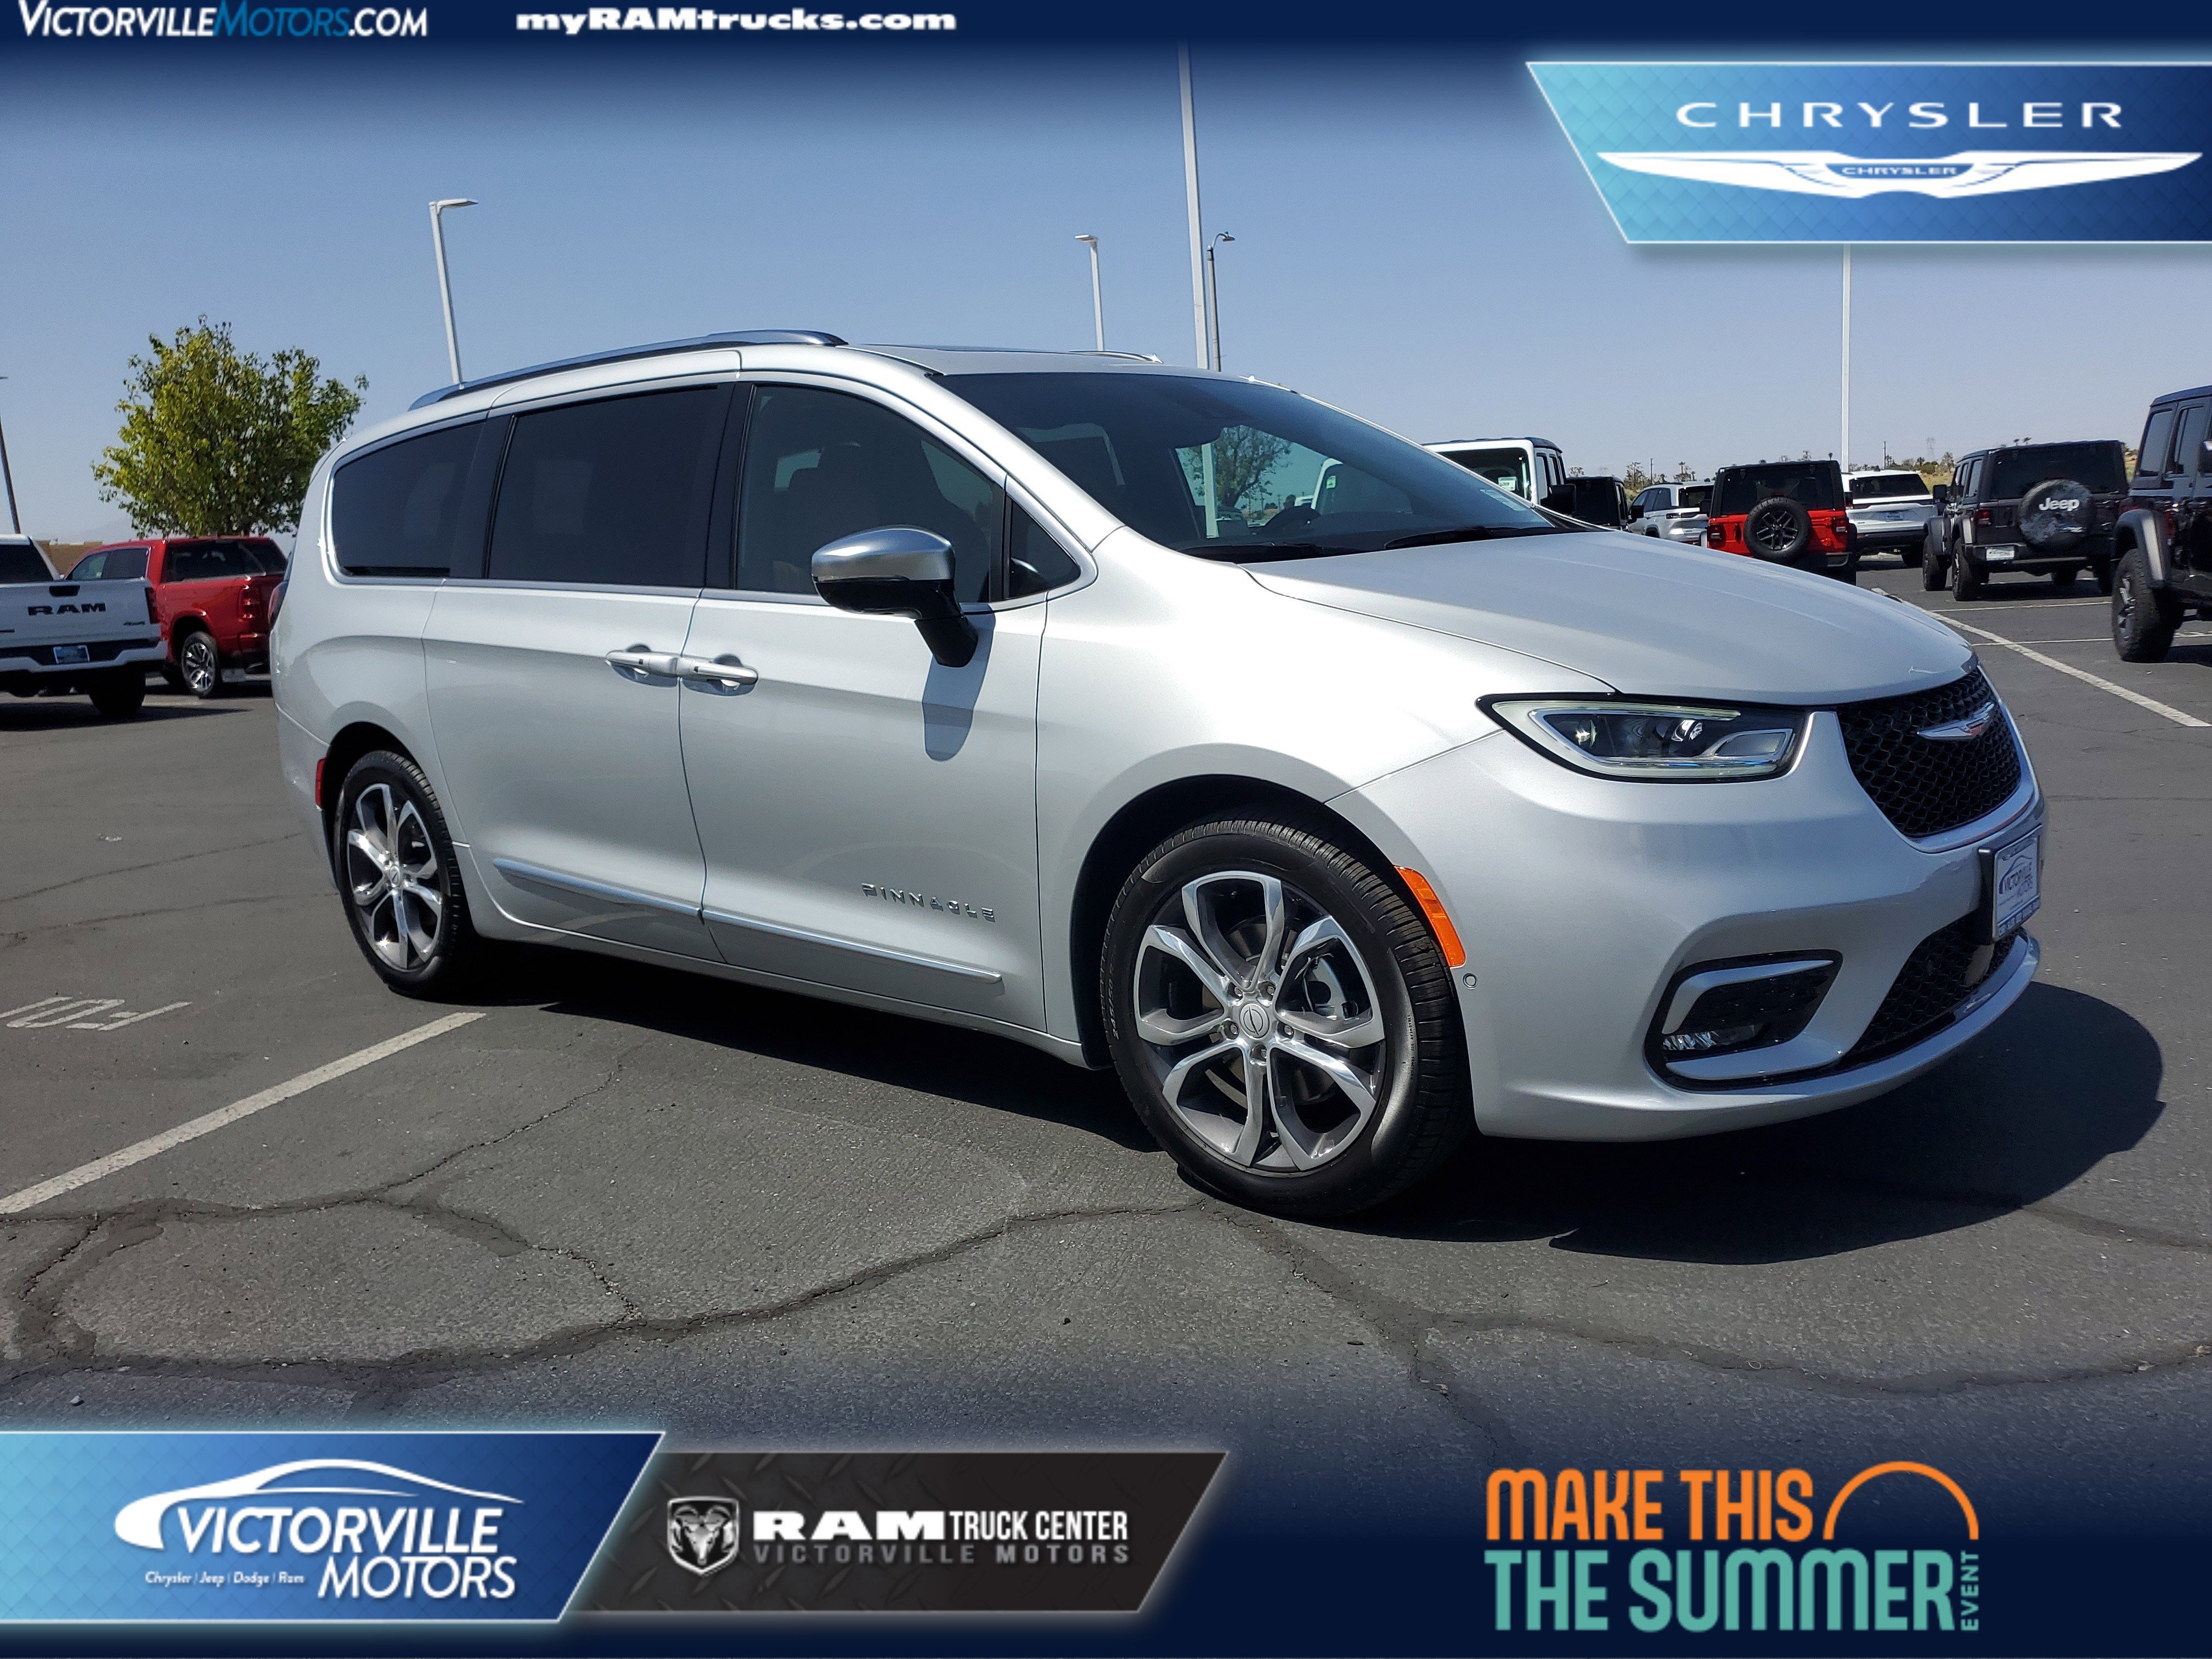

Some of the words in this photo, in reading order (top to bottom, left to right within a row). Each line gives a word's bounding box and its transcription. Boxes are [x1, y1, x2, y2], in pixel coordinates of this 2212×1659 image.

[2039, 497, 2080, 512] Jeep
[28, 603, 106, 616] RAM
[861, 882, 995, 923] PINNACLE
